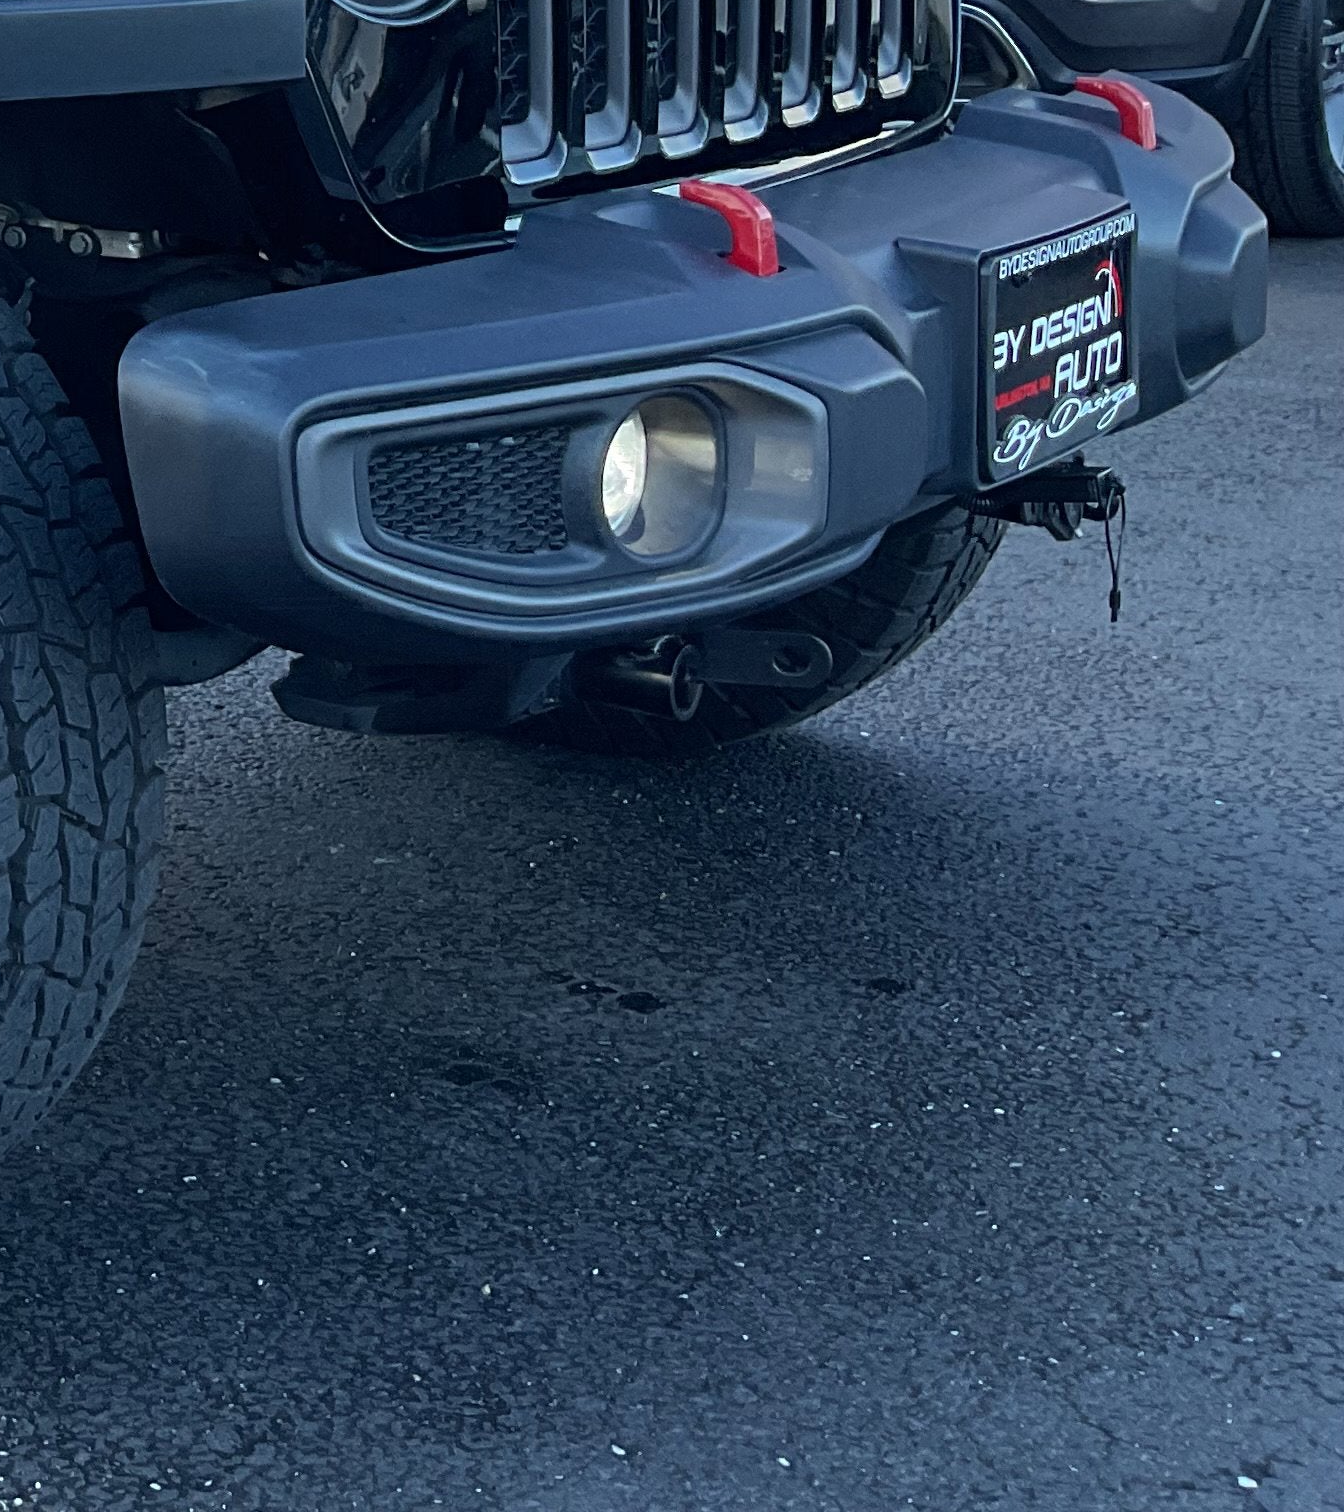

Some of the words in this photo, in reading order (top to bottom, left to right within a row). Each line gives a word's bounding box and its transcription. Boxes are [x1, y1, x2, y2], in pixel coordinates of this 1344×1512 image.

[999, 213, 1135, 280] BYDESIGNAUTOGROUP.COM
[993, 324, 1026, 370] BY
[1030, 290, 1112, 356] DESIGN
[1054, 330, 1122, 398] AUTO
[993, 417, 1041, 470] By
[1046, 382, 1137, 439] Design
